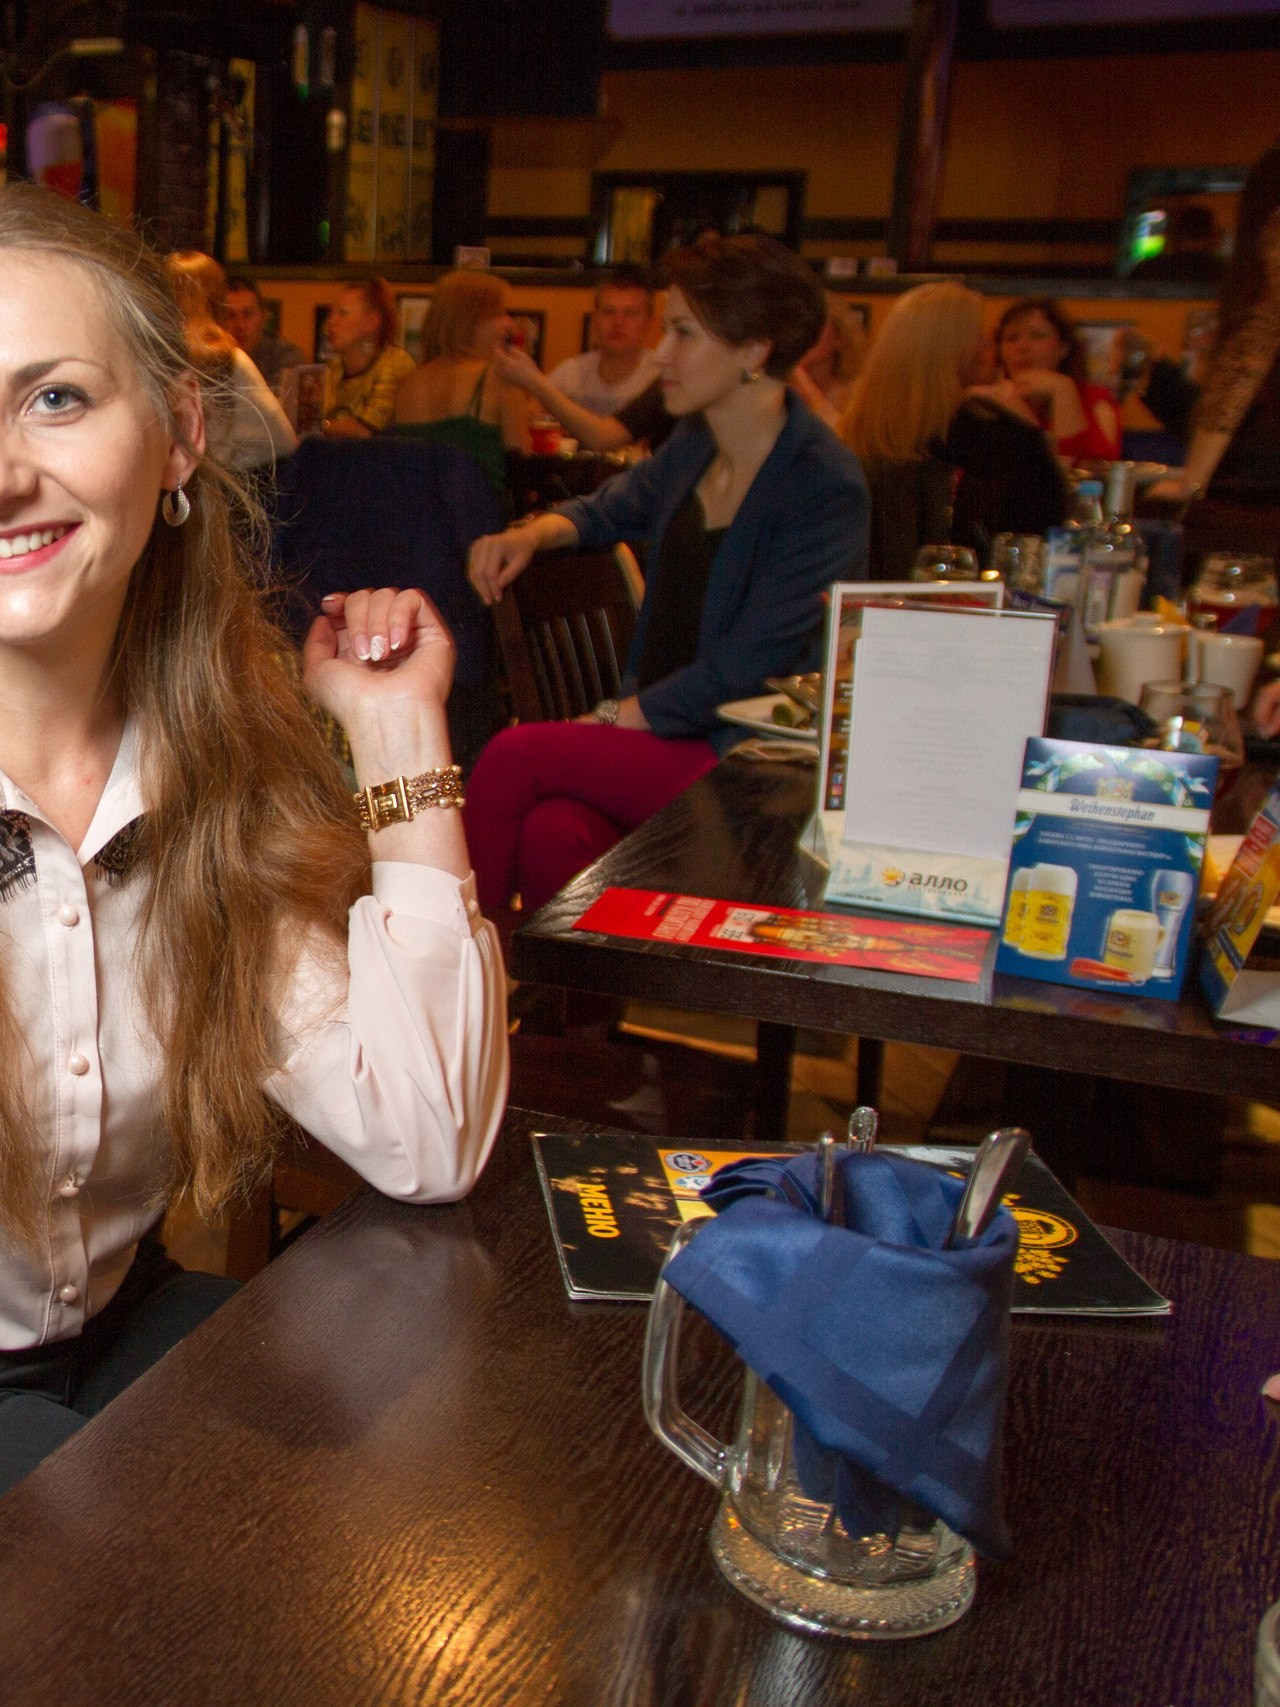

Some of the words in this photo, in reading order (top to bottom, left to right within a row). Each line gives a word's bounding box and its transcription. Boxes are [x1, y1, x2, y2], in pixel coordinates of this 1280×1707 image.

[1070, 798, 1156, 822] Weihenstephan
[909, 872, 968, 892] алло
[576, 1183, 621, 1238] МЕНЮ
